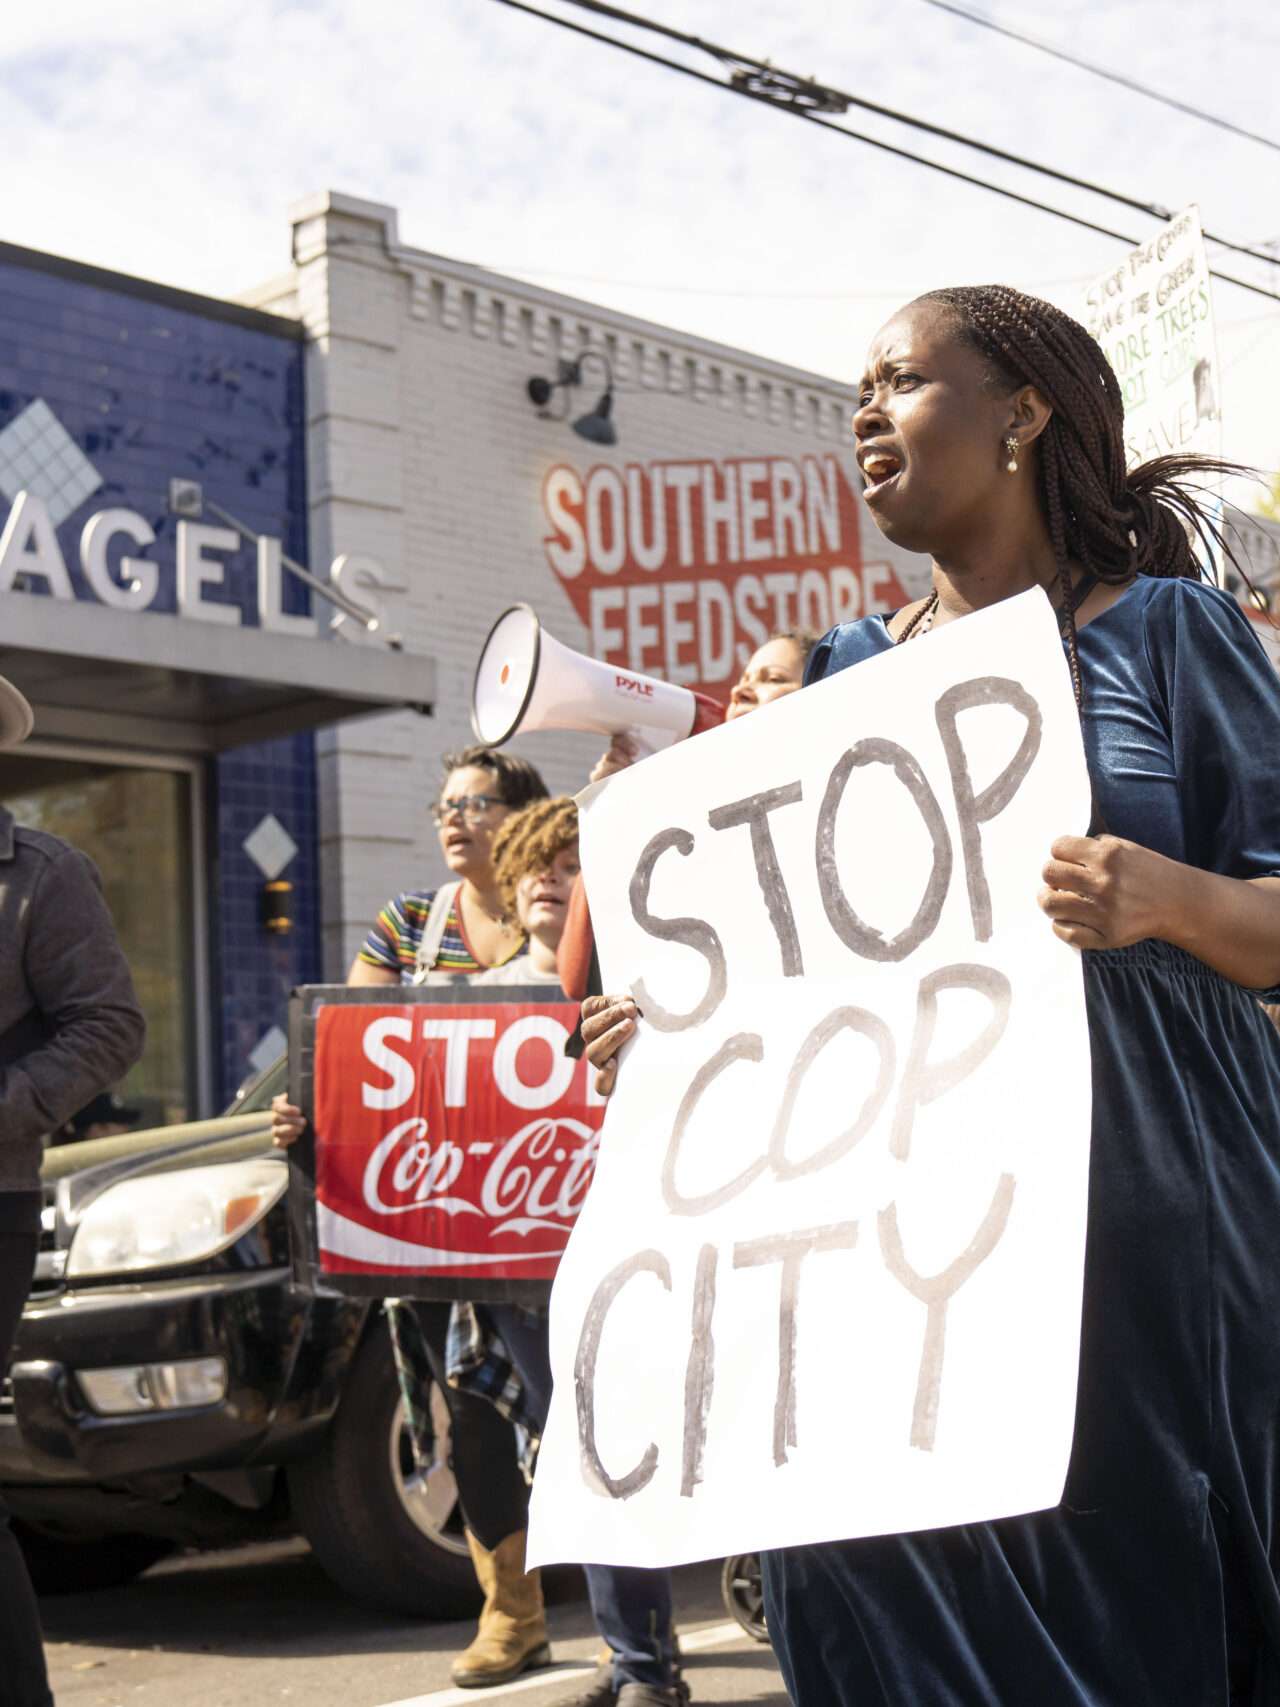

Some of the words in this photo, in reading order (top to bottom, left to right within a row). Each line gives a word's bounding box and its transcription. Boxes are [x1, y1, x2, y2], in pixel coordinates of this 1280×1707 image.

[1156, 280, 1209, 341] TREES
[1128, 403, 1190, 465] SAVE
[546, 455, 842, 579] SOUTHERN
[616, 676, 654, 697] PYLE
[627, 675, 1043, 1034] STOP
[362, 1015, 607, 1111] STO
[661, 962, 1011, 1216] COP
[362, 1117, 602, 1222] Cop-Cit
[574, 1172, 1015, 1500] CITY
